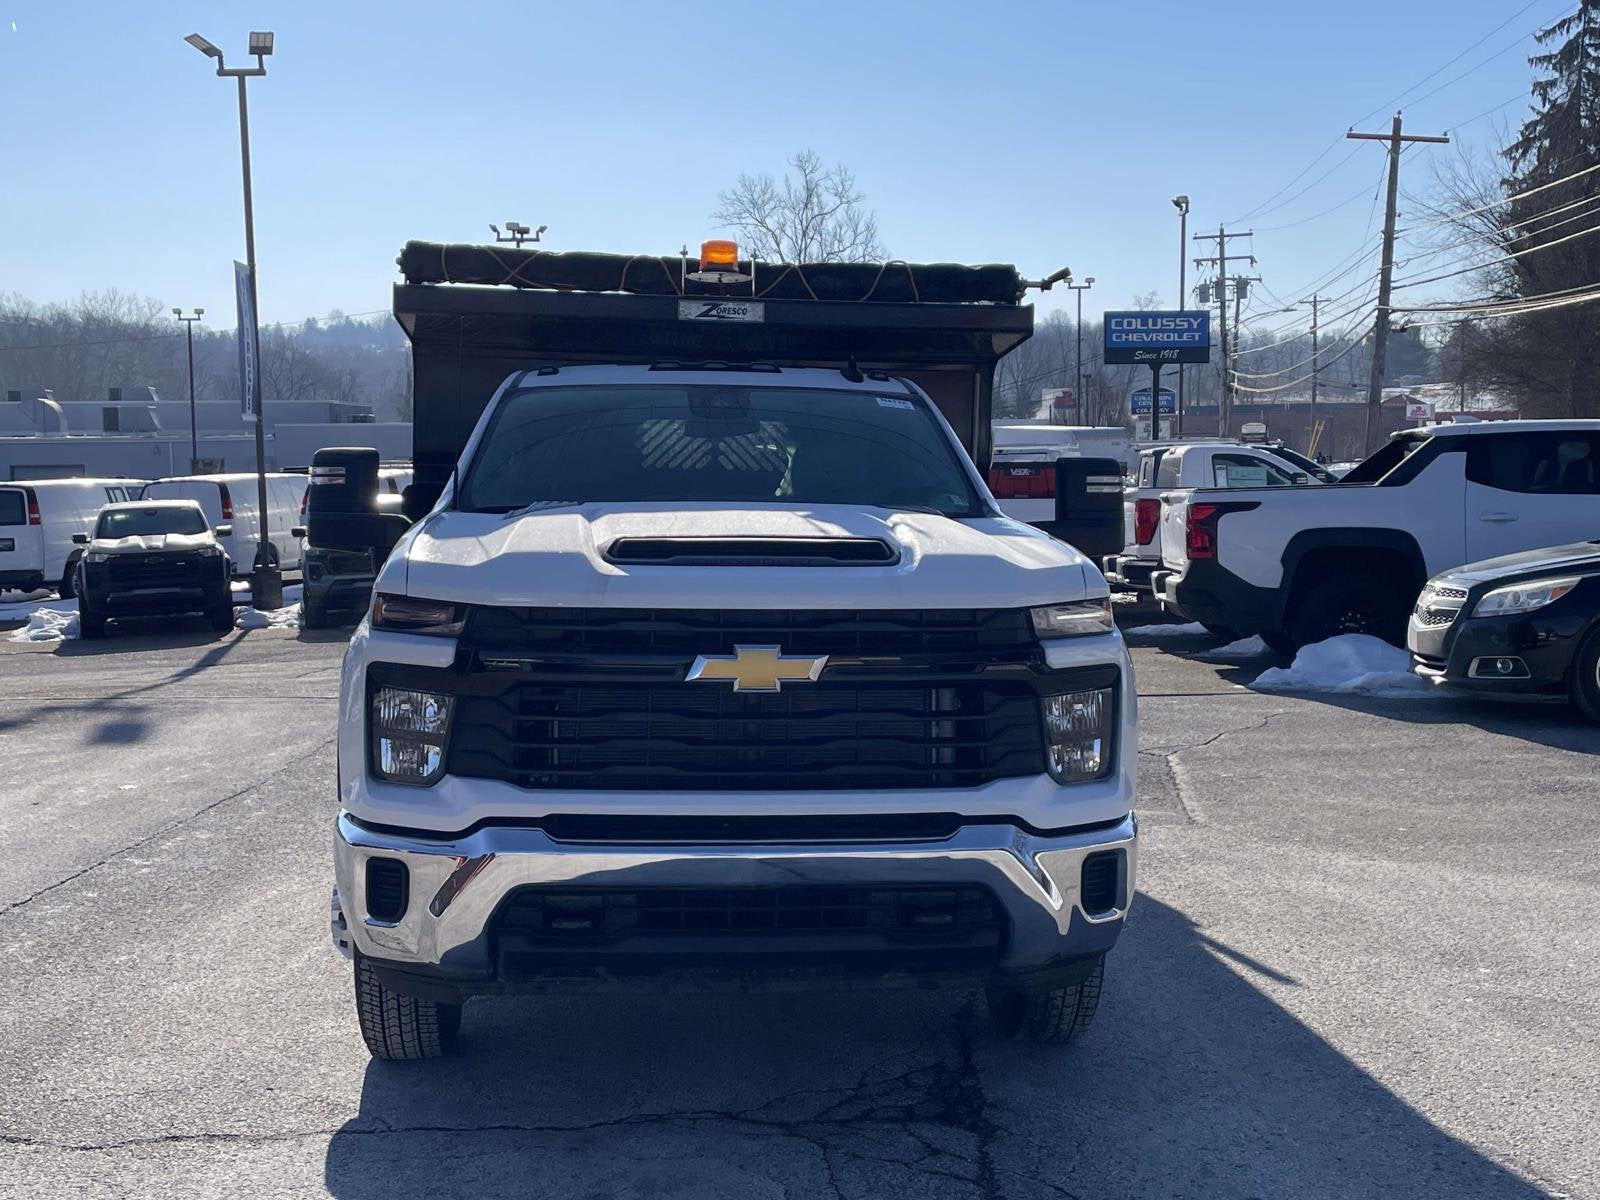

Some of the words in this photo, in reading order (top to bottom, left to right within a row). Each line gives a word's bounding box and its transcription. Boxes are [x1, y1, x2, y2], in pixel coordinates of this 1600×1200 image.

[695, 302, 748, 319] ZORESCO
[1111, 318, 1202, 330] COLUSSY
[1112, 332, 1202, 342] CHEVROLET
[1134, 351, 1157, 360] Since
[1160, 349, 1179, 359] 1918
